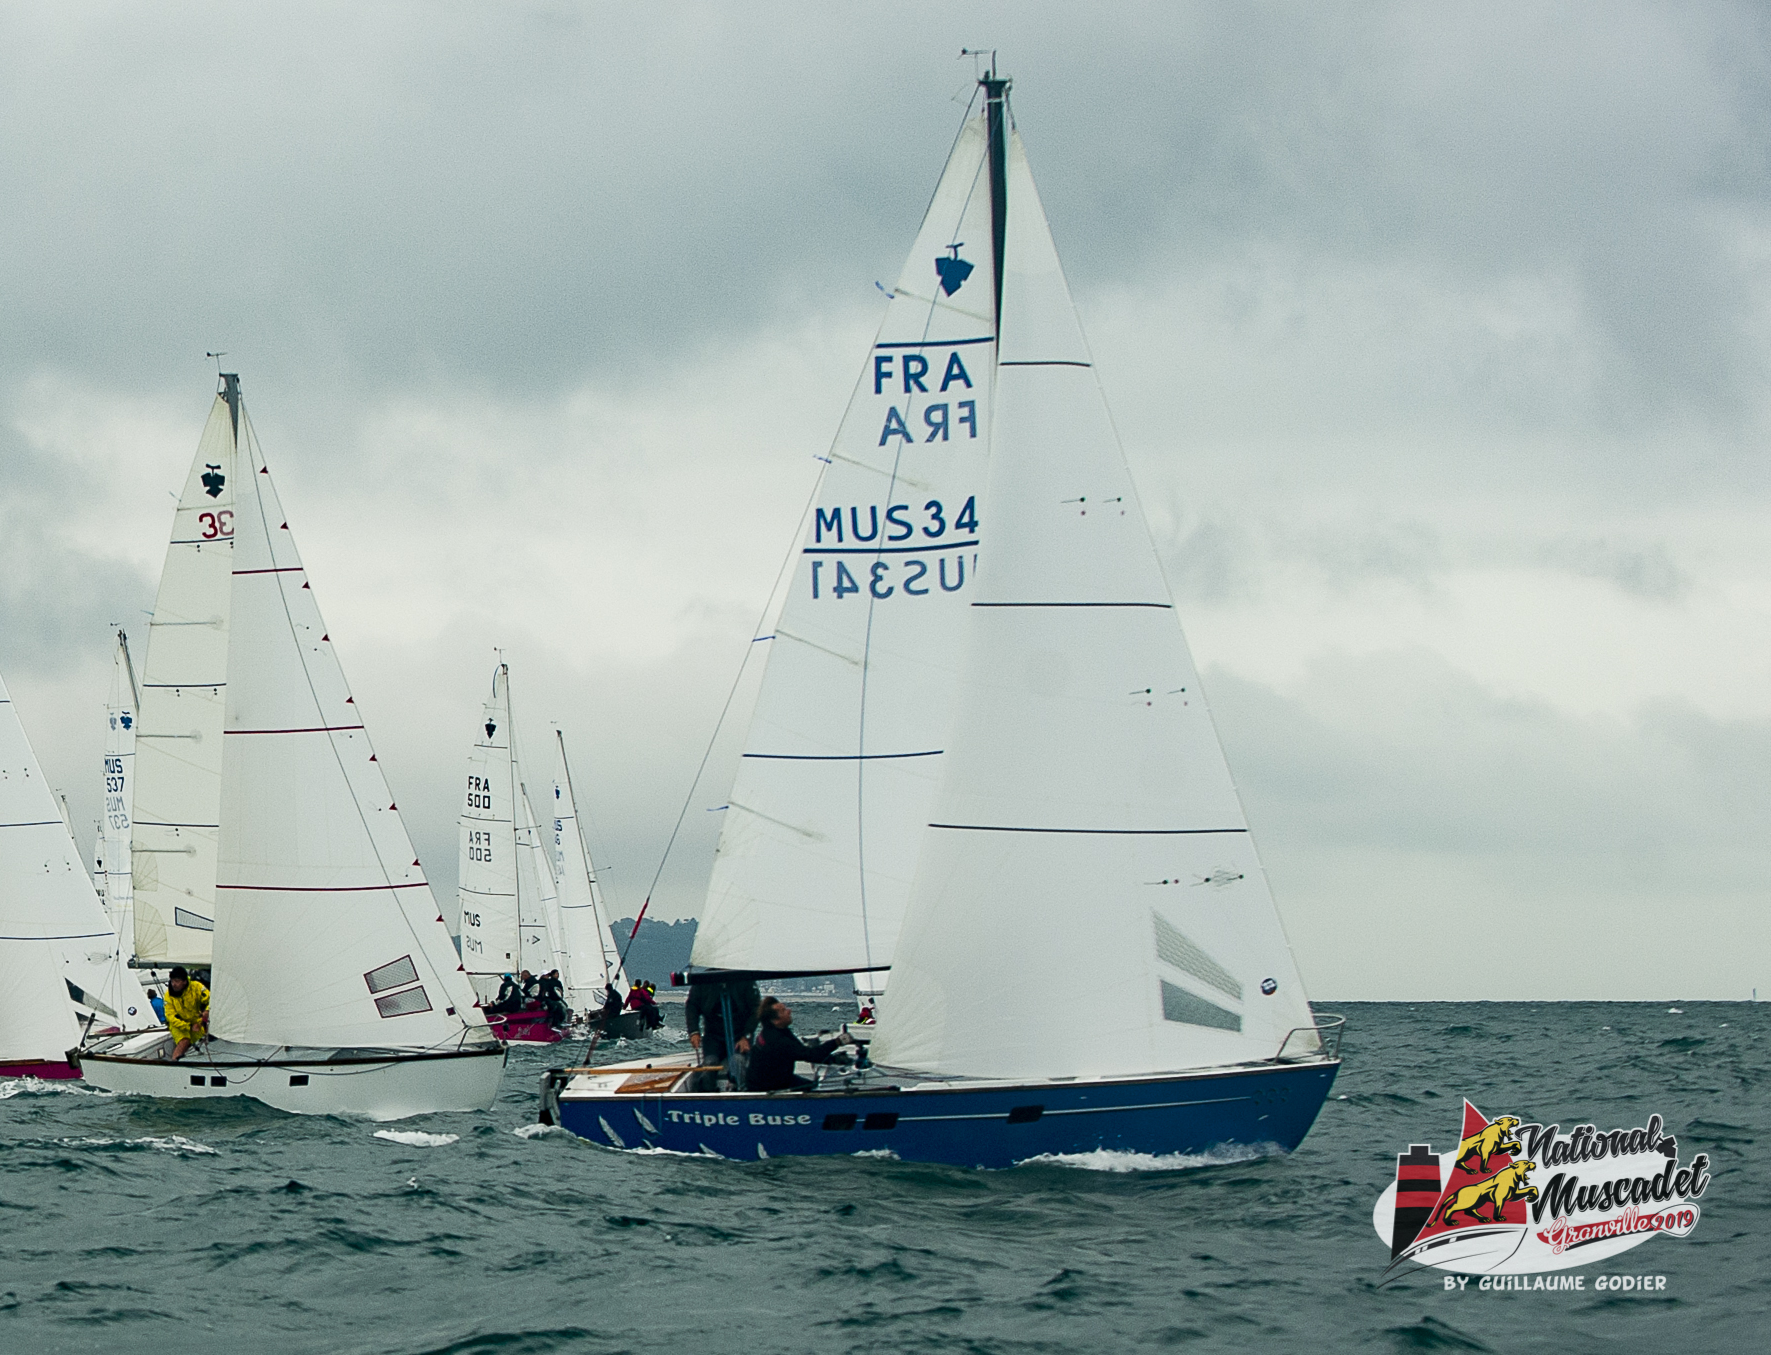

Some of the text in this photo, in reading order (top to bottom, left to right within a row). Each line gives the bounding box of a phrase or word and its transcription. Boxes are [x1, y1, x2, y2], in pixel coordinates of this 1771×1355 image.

[874, 352, 973, 394] FRA
[104, 758, 123, 774] MUS
[107, 777, 125, 793] 537
[467, 776, 490, 793] FRA
[467, 795, 491, 809] 500
[463, 910, 481, 927] MUS
[667, 1110, 811, 1127] Triple Buse
